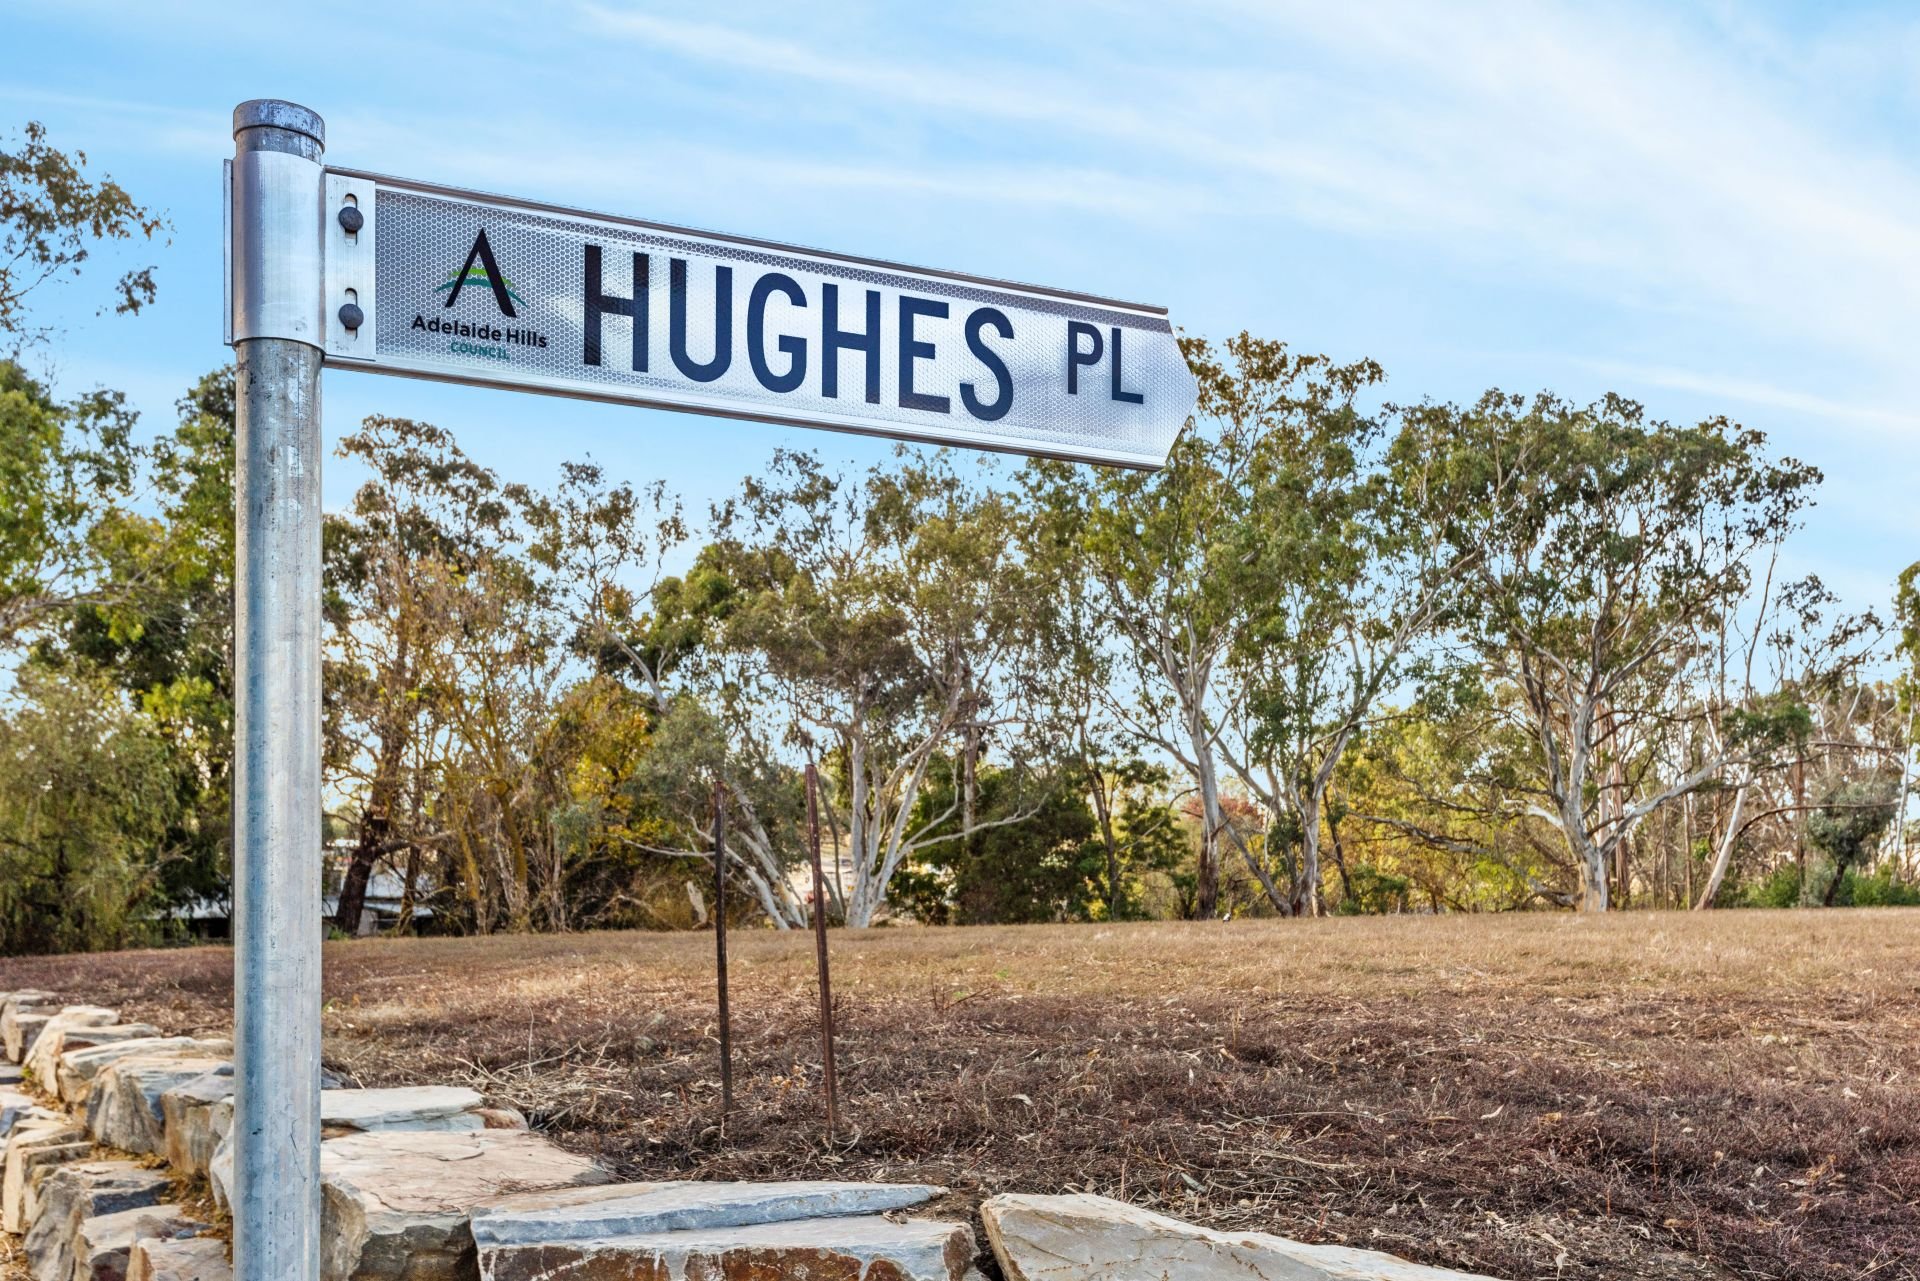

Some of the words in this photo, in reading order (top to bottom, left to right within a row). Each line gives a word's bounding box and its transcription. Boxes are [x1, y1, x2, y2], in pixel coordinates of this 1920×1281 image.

[411, 315, 502, 341] Adelaide
[506, 328, 548, 348] Hills
[583, 244, 1015, 422] HUGHES
[1067, 319, 1145, 405] PL
[450, 341, 510, 360] COUNCIL
